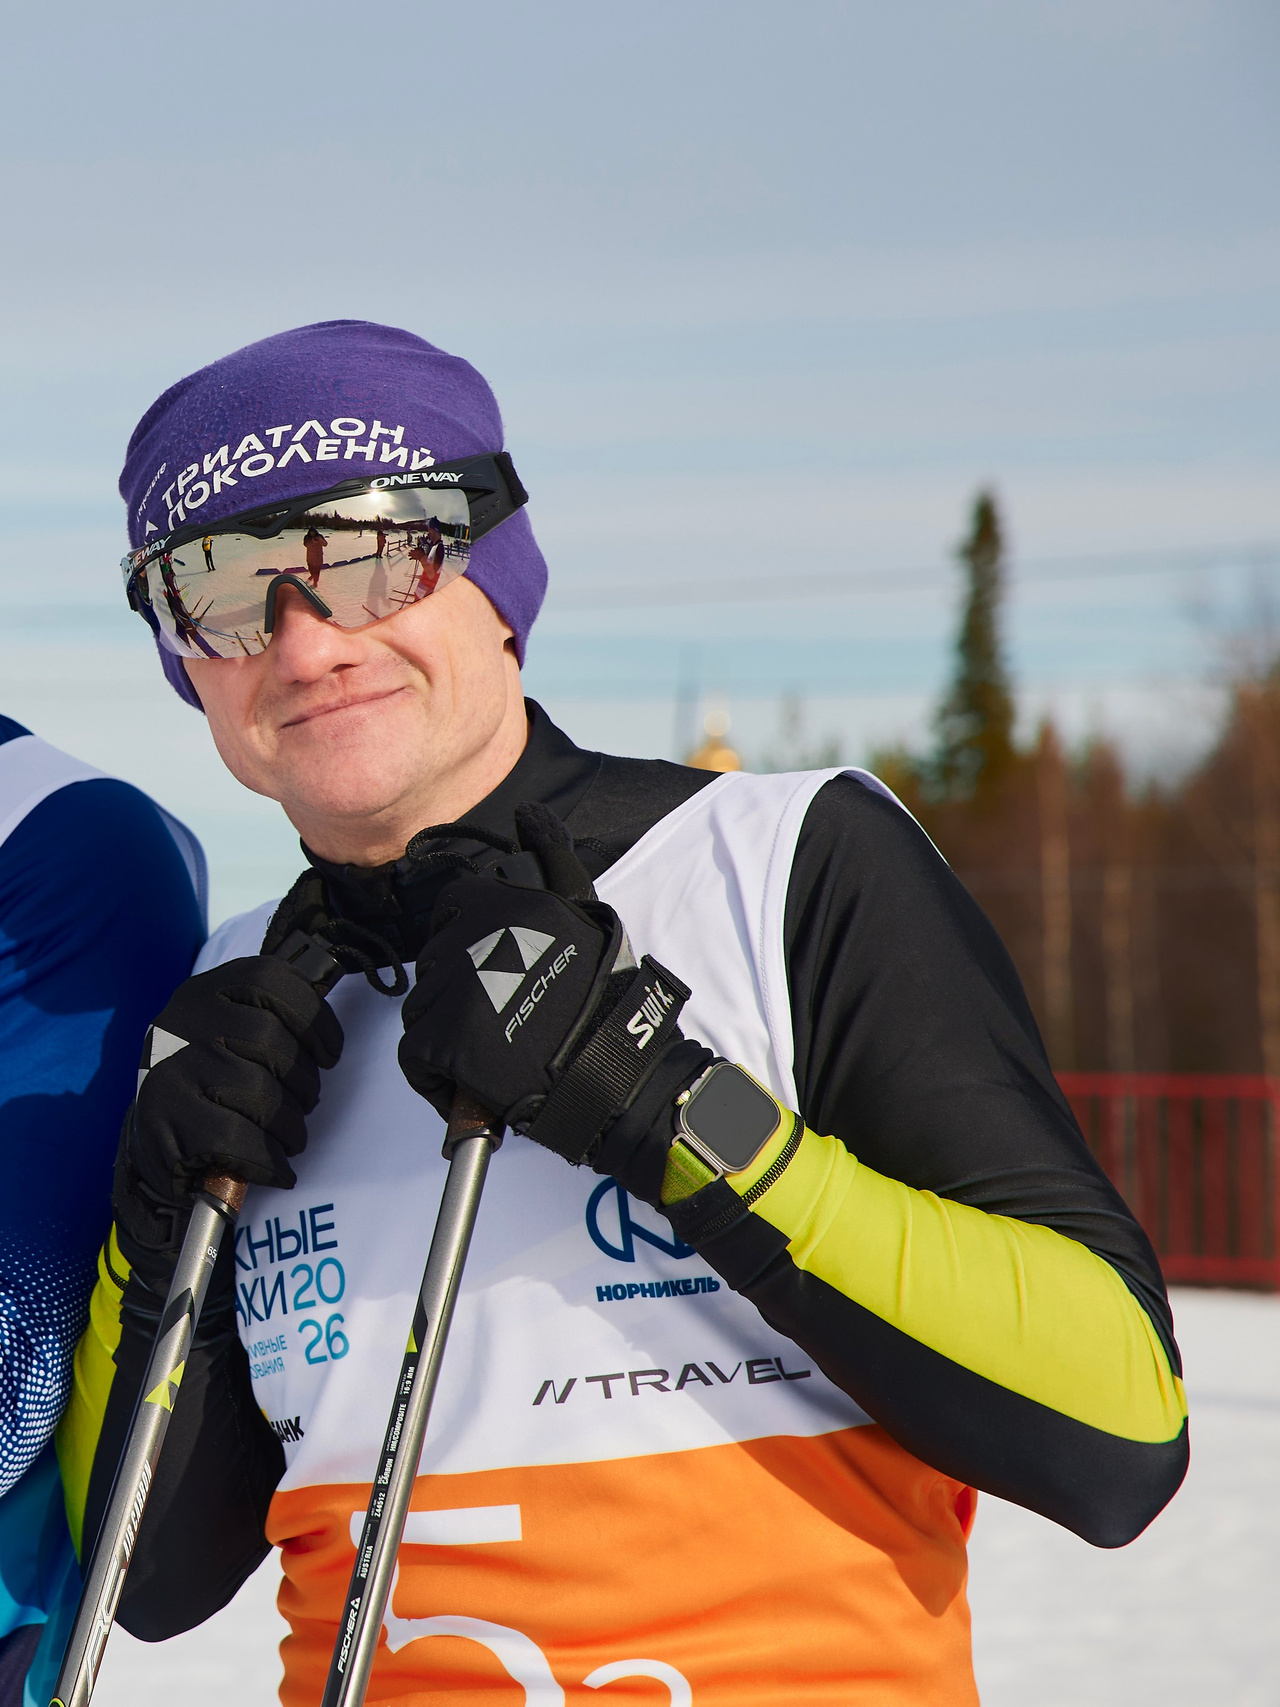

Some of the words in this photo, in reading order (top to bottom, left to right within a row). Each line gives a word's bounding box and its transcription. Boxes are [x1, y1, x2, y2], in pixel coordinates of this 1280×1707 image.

[162, 417, 406, 510] ТРИАТЛОН
[504, 944, 578, 1043] FISCHER
[290, 1257, 346, 1311] 20
[596, 1277, 720, 1302] НОРНИКЕЛЬ
[298, 1313, 350, 1365] 26
[585, 1357, 811, 1399] TRAVEL
[382, 1458, 394, 1485] CARBON
[360, 1545, 374, 1579] AUSTRIA
[337, 1608, 358, 1674] FISCHER
